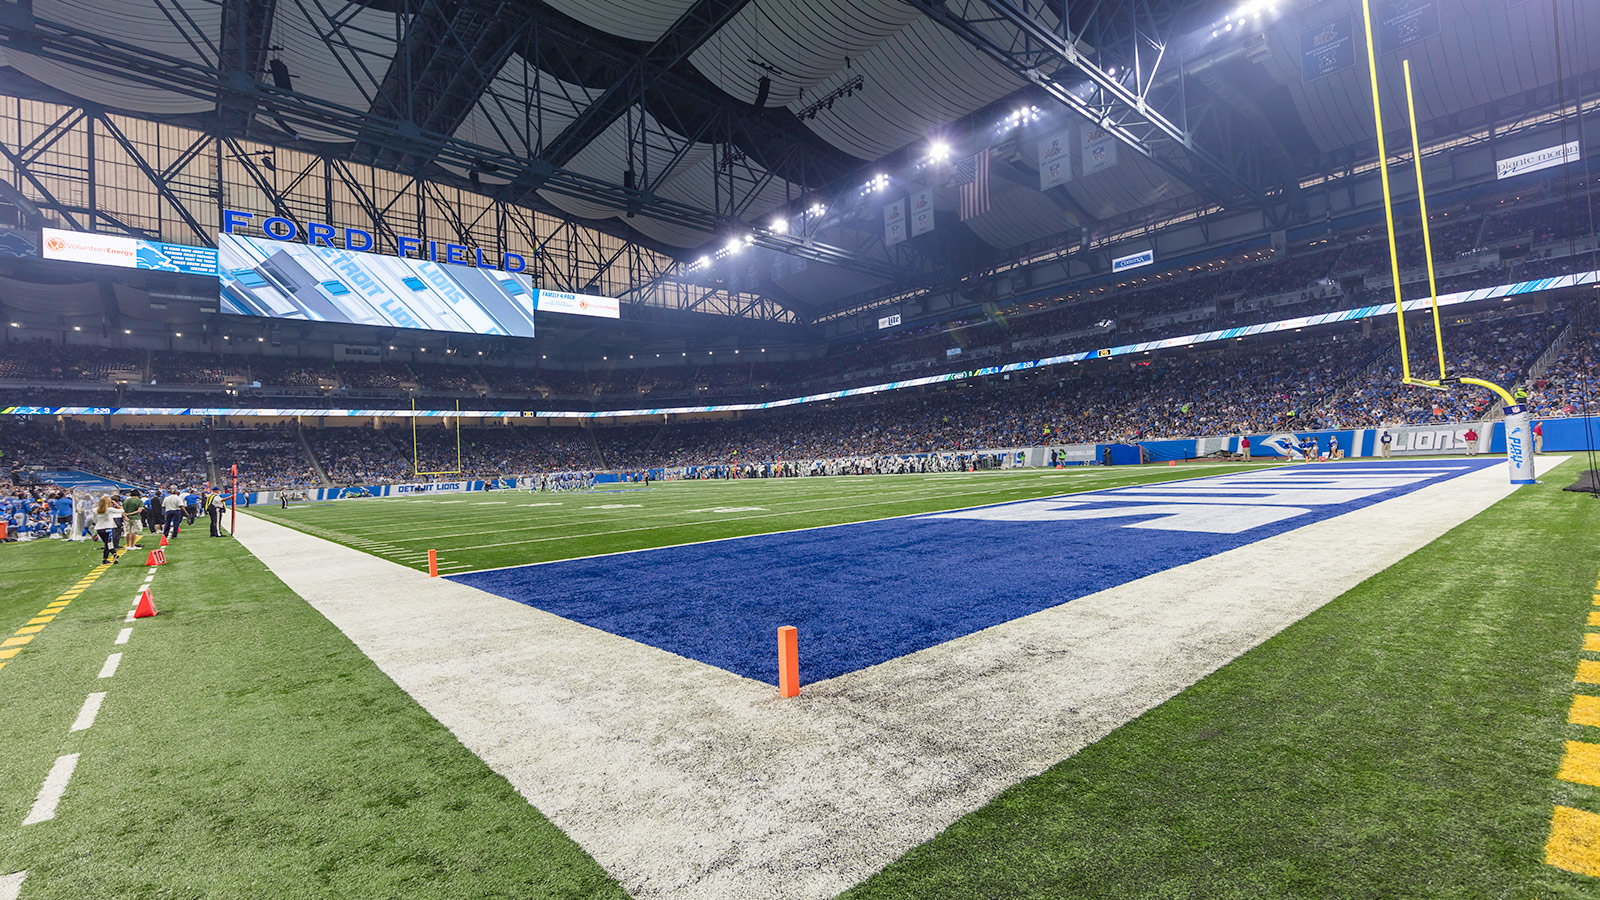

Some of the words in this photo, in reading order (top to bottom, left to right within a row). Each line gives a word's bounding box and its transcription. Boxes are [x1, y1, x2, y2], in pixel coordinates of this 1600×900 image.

[1498, 156, 1534, 173] plante
[1538, 145, 1578, 161] moran
[224, 209, 373, 252] FORD
[398, 235, 526, 273] FIELD
[1389, 429, 1469, 451] LIONS
[398, 485, 434, 493] DETIT
[436, 483, 460, 491] LIONS
[154, 550, 165, 563] 10
